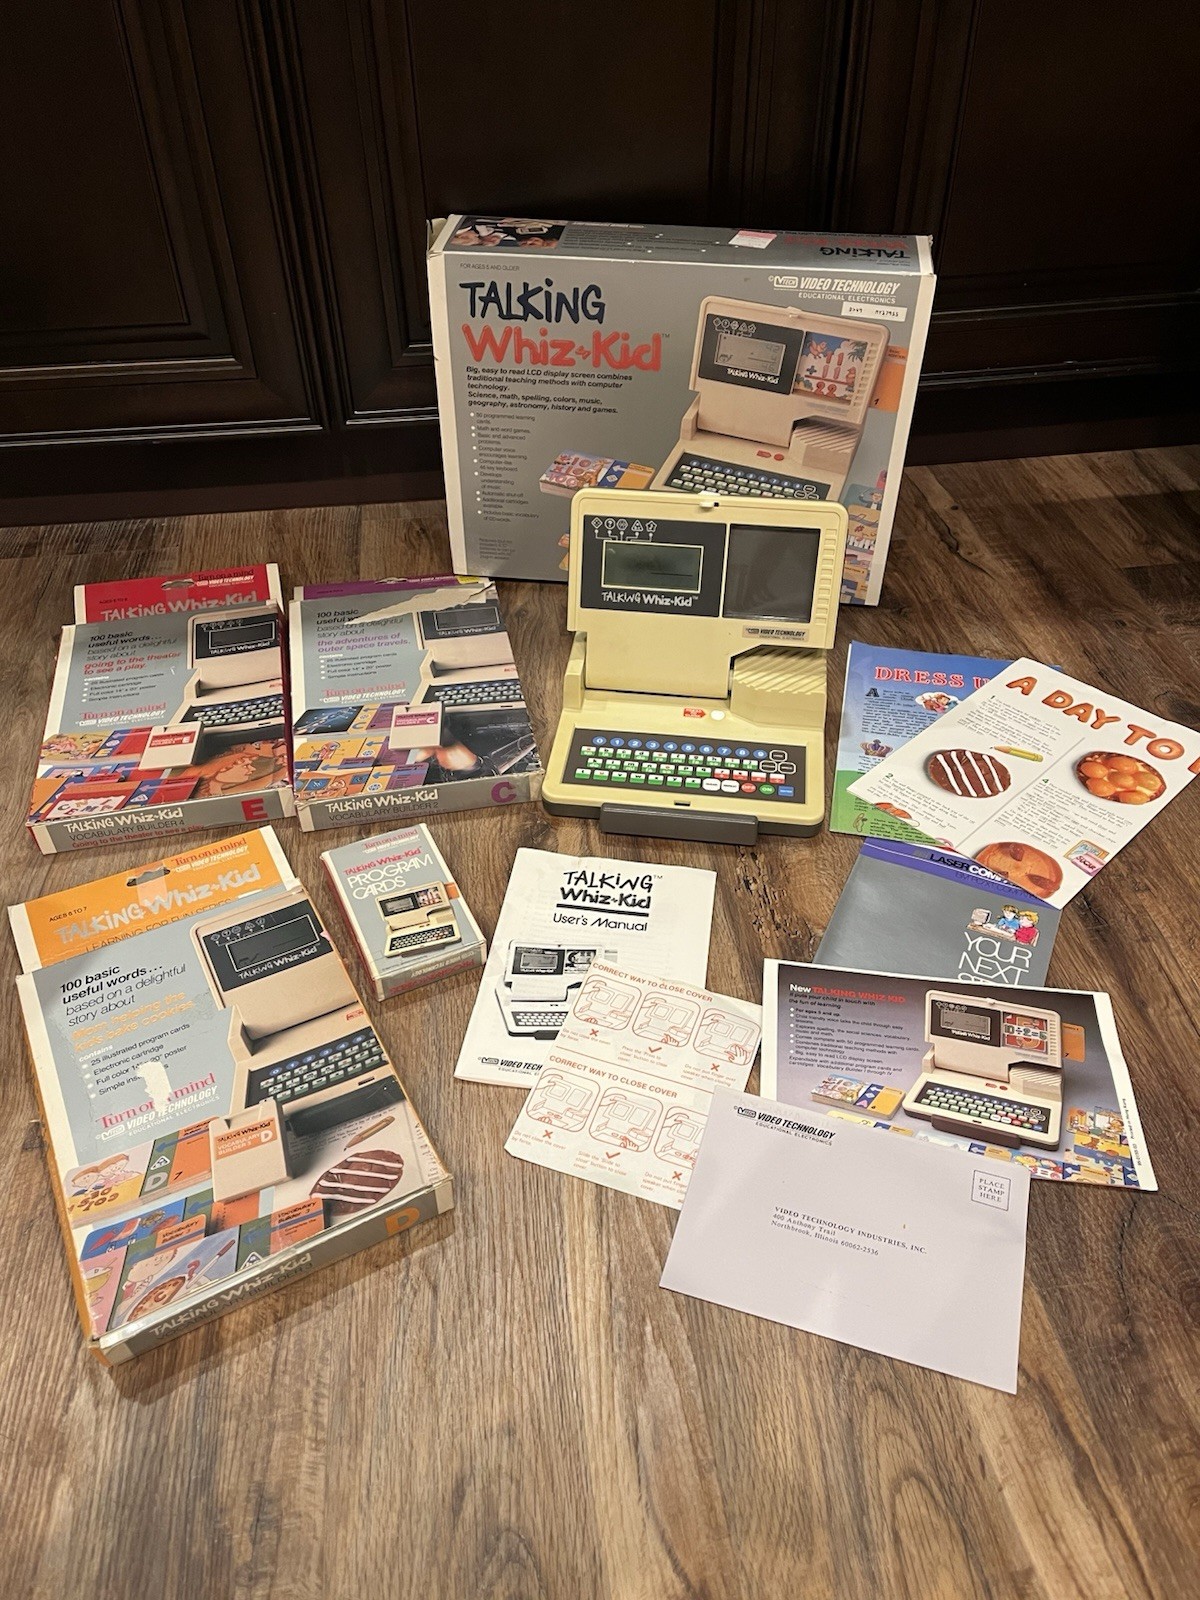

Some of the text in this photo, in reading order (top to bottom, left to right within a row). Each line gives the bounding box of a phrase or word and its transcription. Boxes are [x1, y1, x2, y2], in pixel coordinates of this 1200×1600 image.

[800, 277, 832, 290] VIDEO
[831, 278, 900, 295] TECHNOLOGY
[459, 278, 606, 324] TALKING
[798, 292, 896, 304] EDUCATIONAL ELECTRONICS
[826, 352, 844, 366] 11
[466, 366, 480, 374] Big,
[482, 367, 498, 375] easy
[543, 370, 569, 378] display
[571, 371, 595, 379] screen
[597, 373, 633, 381] combines
[467, 374, 503, 382] traditional
[505, 376, 536, 385] teaching
[538, 378, 569, 386] methods
[588, 381, 623, 389] computer
[467, 382, 510, 391] technology.
[816, 381, 837, 396] 22
[468, 391, 602, 405] Science, math, spelling, colors, music,
[468, 400, 508, 408] geography,
[510, 402, 550, 410] astronomy,
[551, 404, 576, 412] history
[602, 591, 640, 604] TALKING
[88, 640, 118, 648] useful
[90, 631, 133, 642] 100 basic
[335, 635, 389, 645] adventures
[346, 643, 375, 651] space
[377, 639, 410, 647] travels.
[84, 661, 114, 670] going
[128, 655, 144, 663] the
[146, 652, 181, 661] theater
[874, 665, 965, 688] DRESS
[1006, 676, 1037, 696] A
[1041, 689, 1121, 729] DAY
[1124, 724, 1185, 760] TO
[325, 798, 373, 813] TALKING
[491, 781, 517, 804] C
[241, 798, 268, 821] E
[329, 808, 391, 822] VOCABULARY
[393, 803, 431, 814] BUILDER
[64, 818, 114, 833] TALKING
[69, 826, 134, 841] VOCABULARY
[137, 821, 175, 832] BUILDER
[172, 855, 197, 866] Turn
[198, 850, 212, 858] on
[220, 837, 247, 852] mind
[347, 853, 434, 889] PROGRAM
[563, 870, 653, 893] TALKING
[352, 875, 407, 899] CARDS
[49, 913, 67, 922] AGES
[54, 903, 147, 944] TALKING
[553, 913, 648, 931] User's Manual
[964, 931, 1032, 968] YOUR
[958, 951, 1029, 985] NEXT
[60, 966, 121, 994] 100 basic
[66, 963, 187, 1016] based on a delightful
[592, 963, 713, 1002] CORRECT WAY TO CLOSE COVER
[62, 982, 103, 1004] useful
[789, 984, 811, 993] New
[811, 986, 857, 998] TALKING
[858, 991, 885, 1001] WHIZ
[68, 994, 135, 1027] story about
[101, 1043, 137, 1061] illustrated
[138, 1031, 169, 1047] program
[169, 1023, 190, 1035] cards
[94, 1044, 164, 1076] Electronic cartridge
[500, 1059, 522, 1069] VIDEO
[549, 1055, 678, 1099] CORRECT WAY TO CLOSE COVER
[126, 1111, 156, 1130] VIDEO
[757, 1112, 782, 1126] VIDEO
[782, 1119, 836, 1140] TECHNOLOGY
[755, 1121, 833, 1146] EDUCATIONAL ELECTRONICS
[978, 1185, 1005, 1196] STAMP
[980, 1178, 1005, 1189] PLACE
[980, 1192, 1002, 1203] HERE
[385, 1207, 420, 1236] D
[773, 1213, 836, 1236] 400 Anthony Trail
[775, 1206, 928, 1255] VIDEO TECHNOLOGY INDUSTRIES, INC.
[771, 1220, 879, 1256] Northbrook, Illinois 60062-2536
[150, 1298, 219, 1336] TALKING
